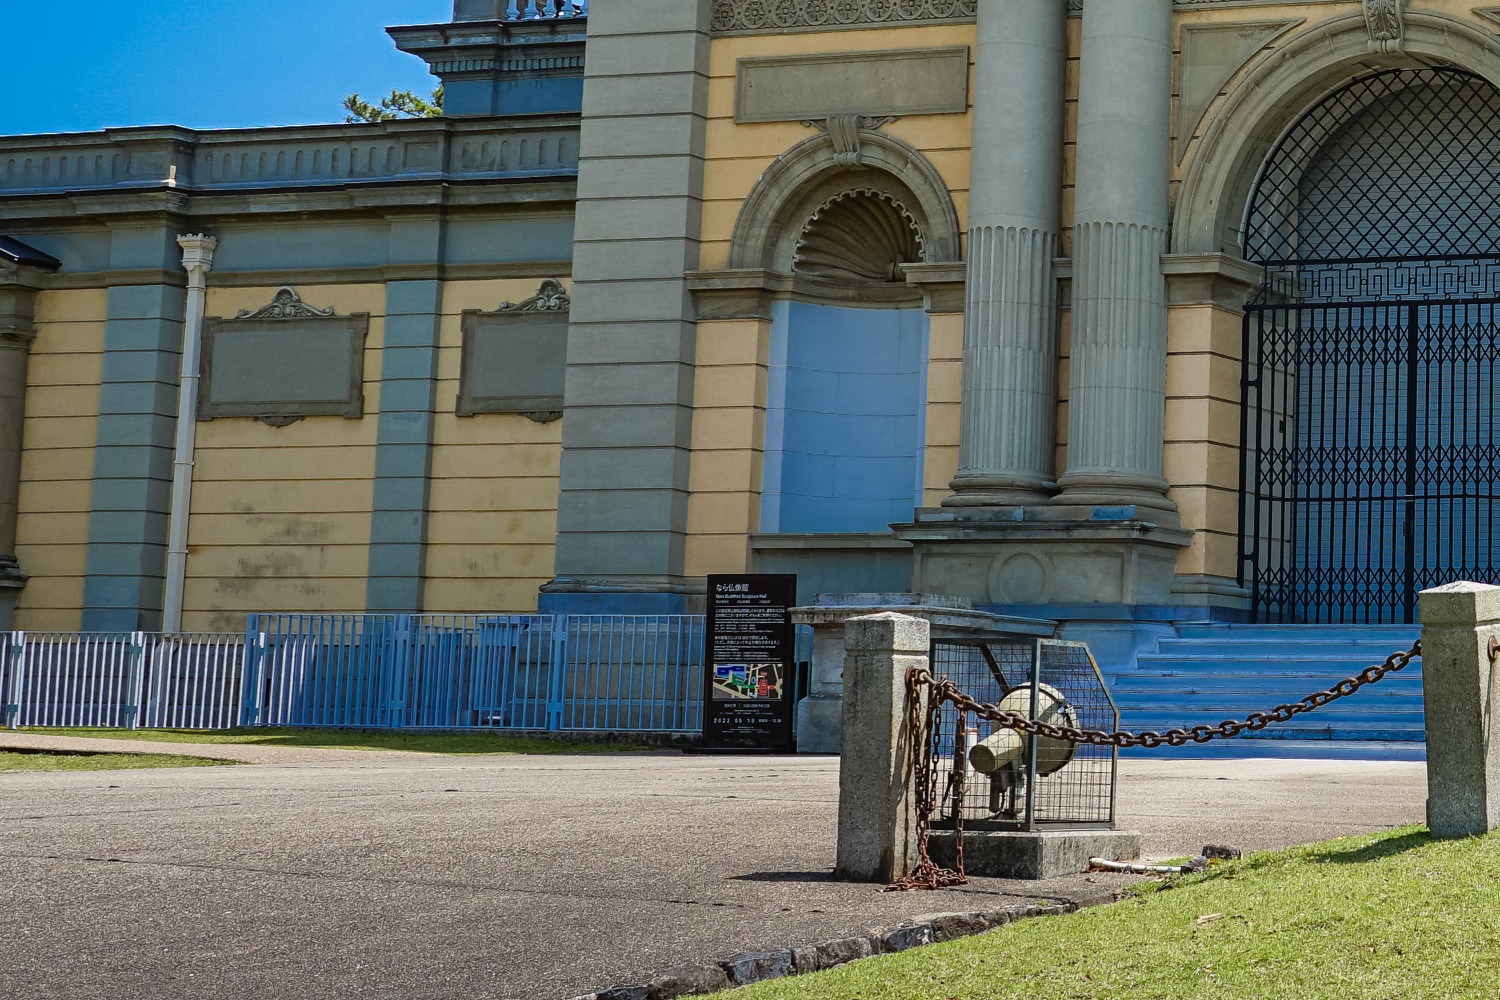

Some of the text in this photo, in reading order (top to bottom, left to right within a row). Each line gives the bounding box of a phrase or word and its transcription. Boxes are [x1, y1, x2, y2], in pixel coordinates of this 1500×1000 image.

[715, 583, 750, 592] なら仏像館
